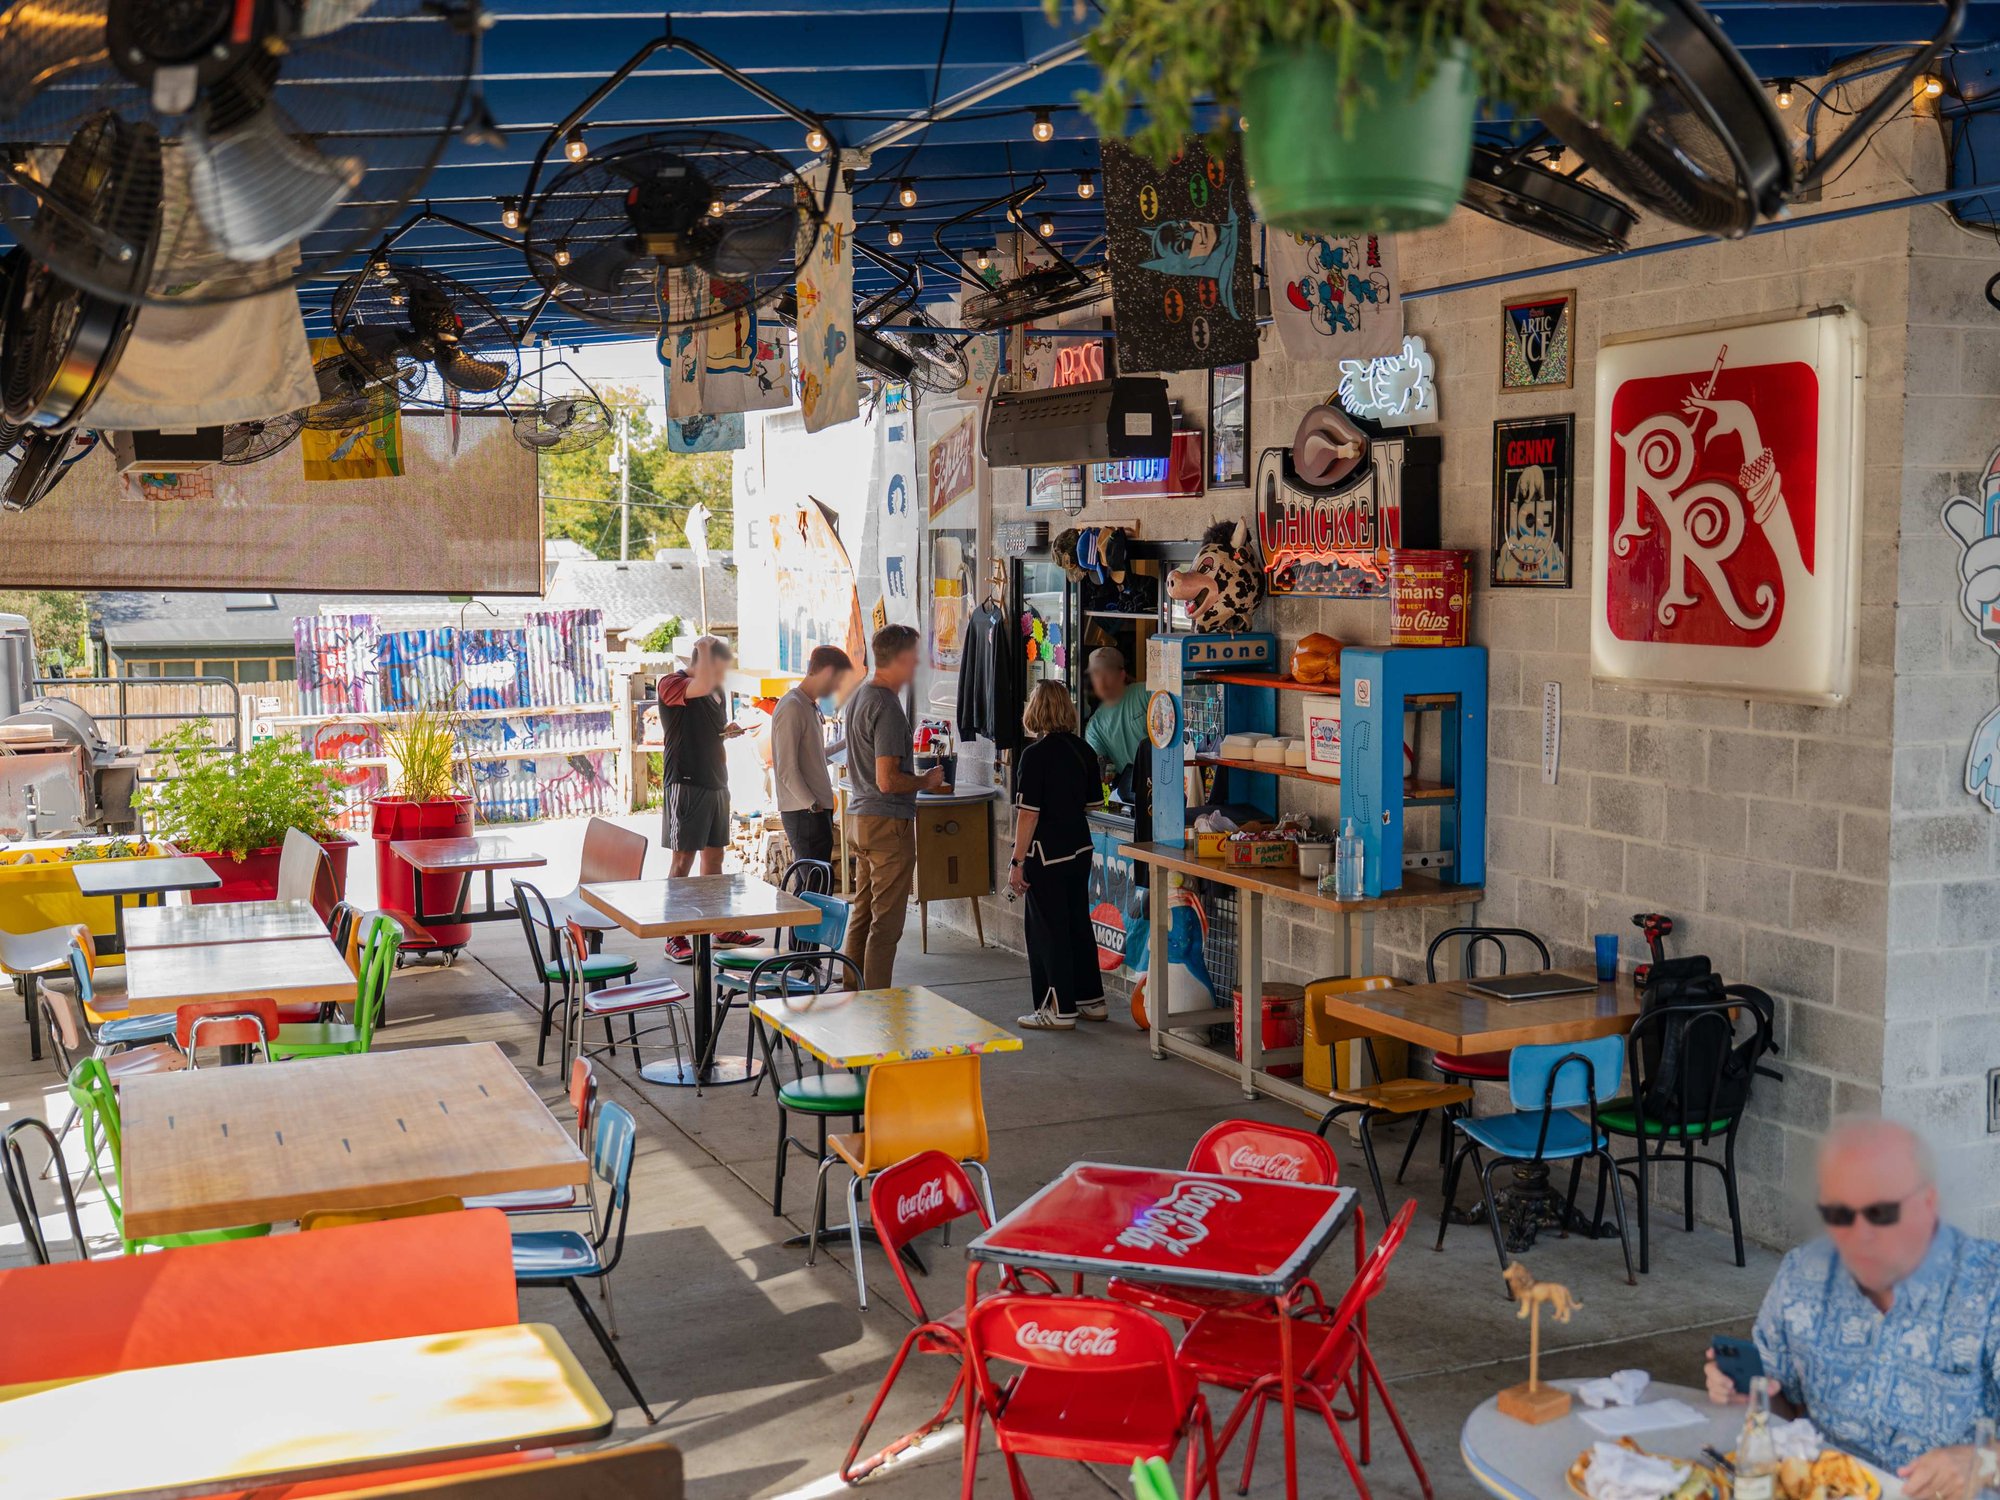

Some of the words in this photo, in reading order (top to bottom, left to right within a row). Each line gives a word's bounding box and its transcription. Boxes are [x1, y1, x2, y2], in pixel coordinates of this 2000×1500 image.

[1520, 315, 1552, 335] ARTIC
[1520, 331, 1551, 363] ICE
[1506, 437, 1556, 467] GENNY
[1258, 439, 1405, 568] CHICKEN
[1510, 501, 1553, 538] ICE
[1005, 539, 1025, 551] COFFEE
[1413, 609, 1450, 631] Chips
[1188, 644, 1266, 660] Phone
[1199, 834, 1220, 842] DRINK
[1255, 843, 1289, 856] FAMILY
[1260, 854, 1285, 863] PACK
[1229, 1145, 1304, 1181] Coca-Cola
[897, 1177, 944, 1224] Coca-Cola
[1115, 1180, 1243, 1258] Coca-Cola
[1015, 1321, 1120, 1356] Coca-Cola
